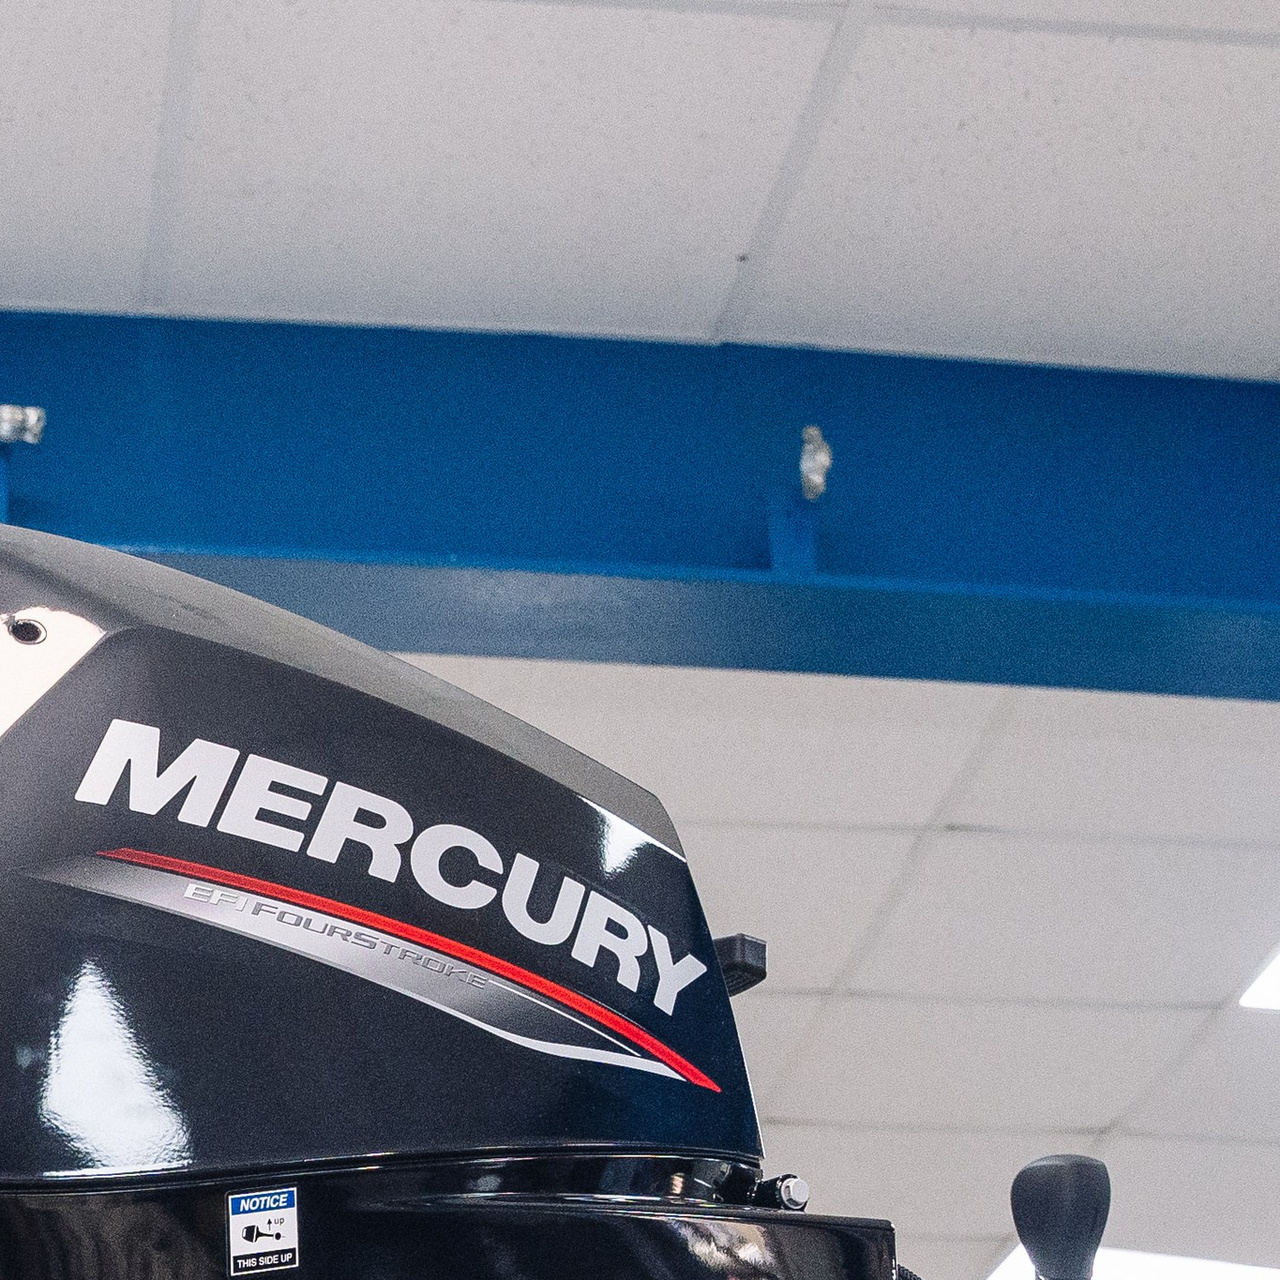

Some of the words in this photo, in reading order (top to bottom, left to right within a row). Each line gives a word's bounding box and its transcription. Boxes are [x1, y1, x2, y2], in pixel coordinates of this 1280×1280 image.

[75, 719, 707, 1016] MERCURY
[251, 902, 489, 989] FOURSTROKE
[240, 1194, 288, 1212] NOTICE
[237, 1258, 257, 1269] THIS
[258, 1255, 279, 1266] SIDE
[280, 1253, 293, 1263] UP
